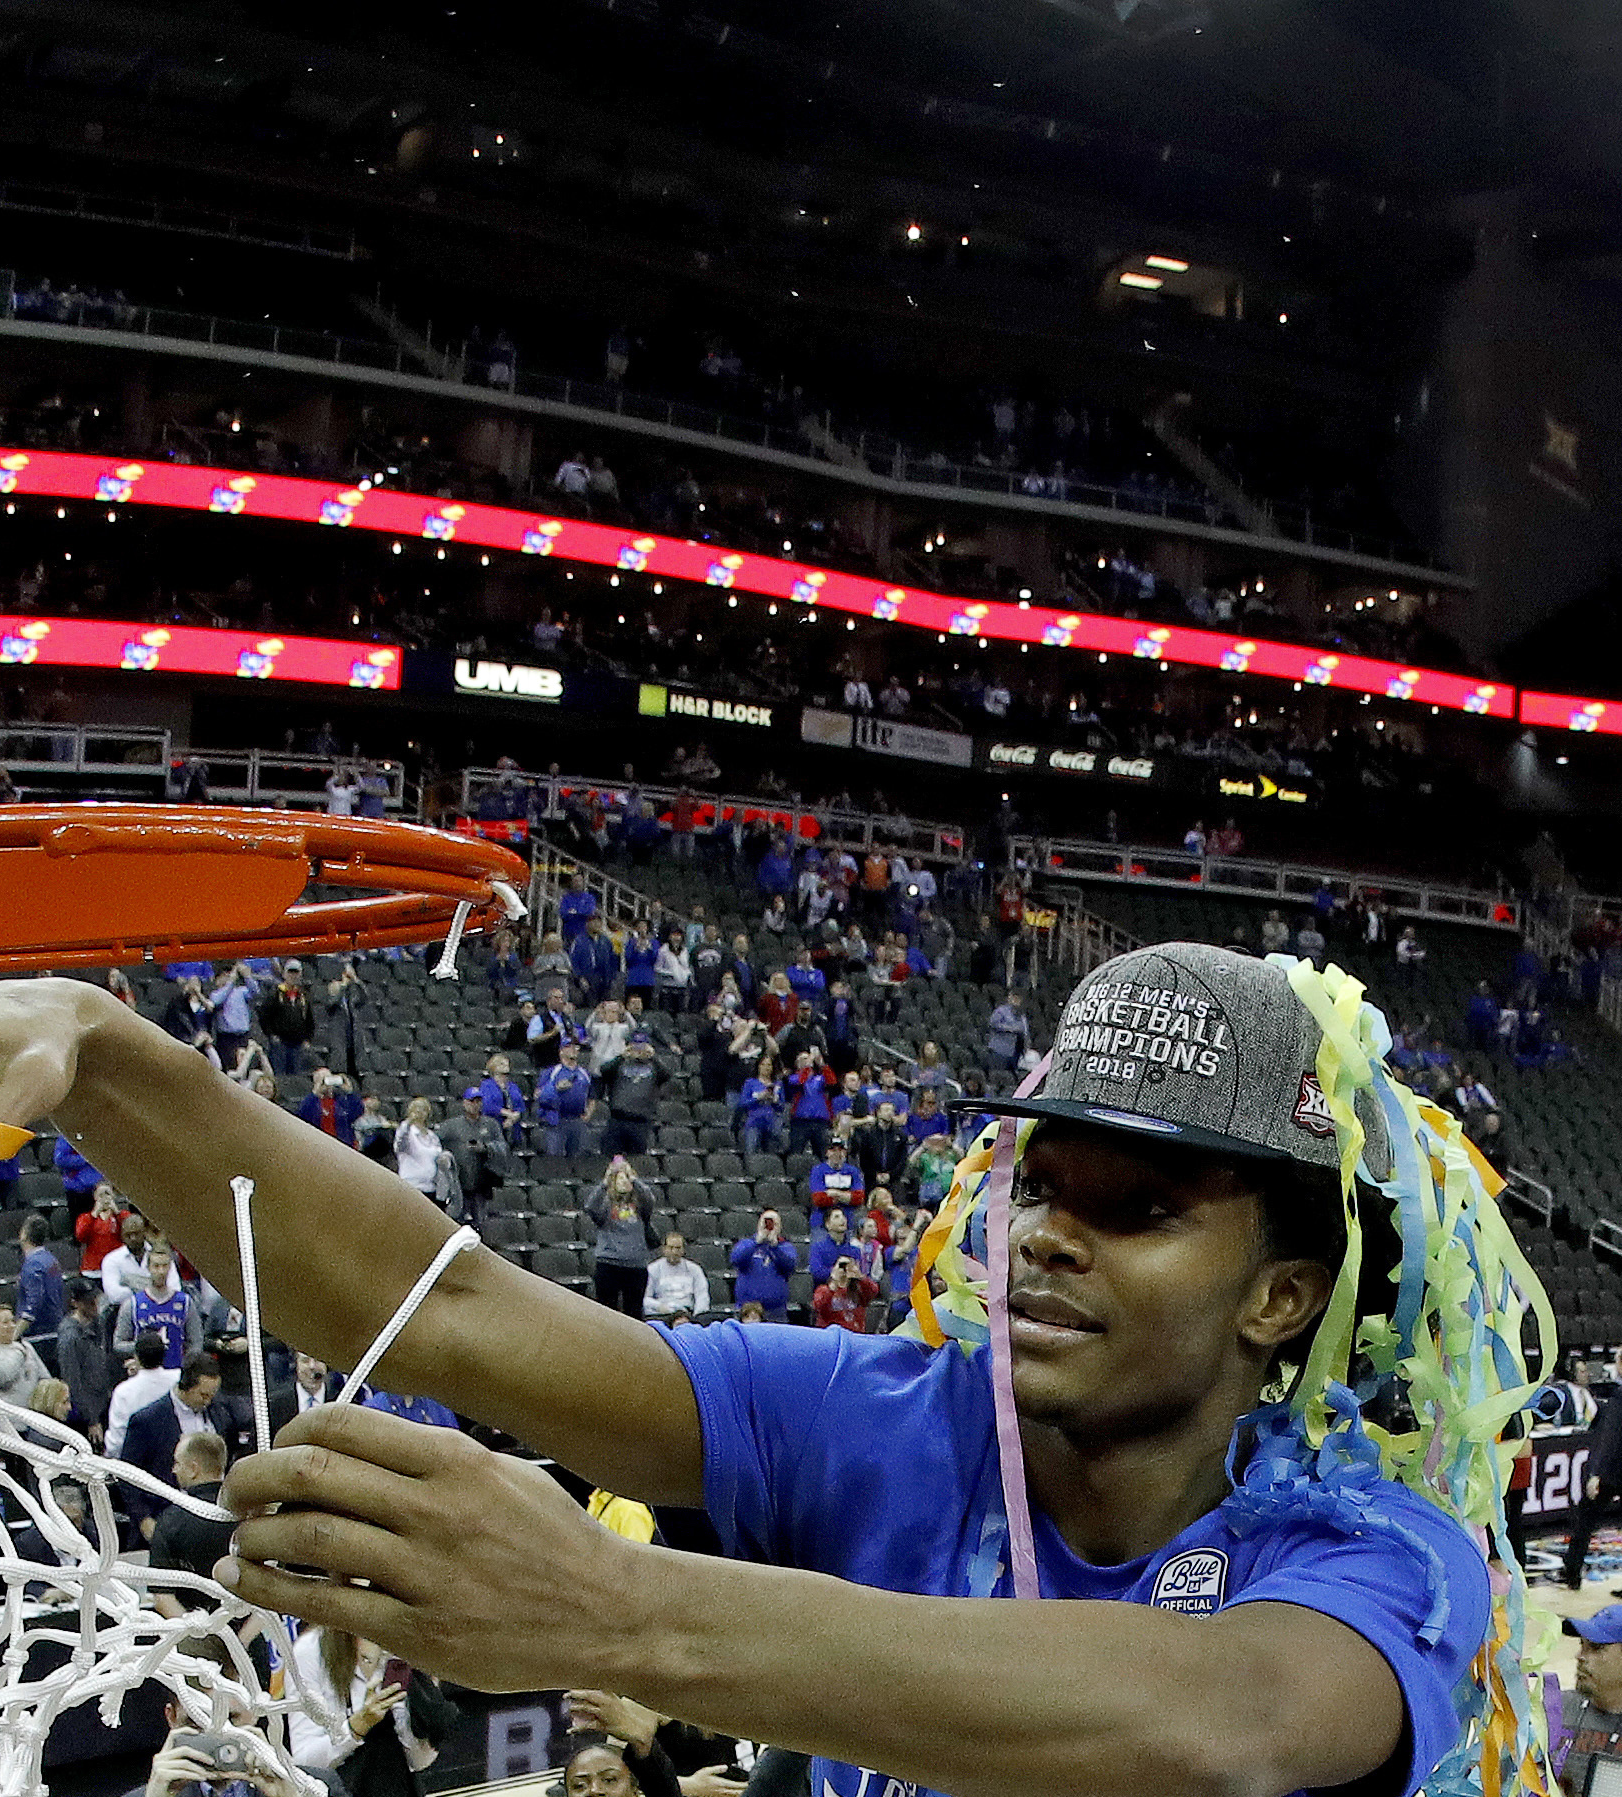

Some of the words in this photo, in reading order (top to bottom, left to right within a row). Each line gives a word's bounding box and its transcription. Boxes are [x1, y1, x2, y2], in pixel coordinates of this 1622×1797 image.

[454, 657, 564, 698] UMB
[670, 693, 710, 717] H&R
[712, 699, 772, 727] BLOCK
[1111, 983, 1134, 1000] 12
[1138, 985, 1211, 1019] MEN'S
[1066, 998, 1229, 1051] BASKETBALL
[1058, 1026, 1221, 1077] CHAMPIONS
[1085, 1056, 1137, 1080] 2018
[1163, 1558, 1219, 1592] Blue
[1160, 1598, 1213, 1612] OFFICIAL
